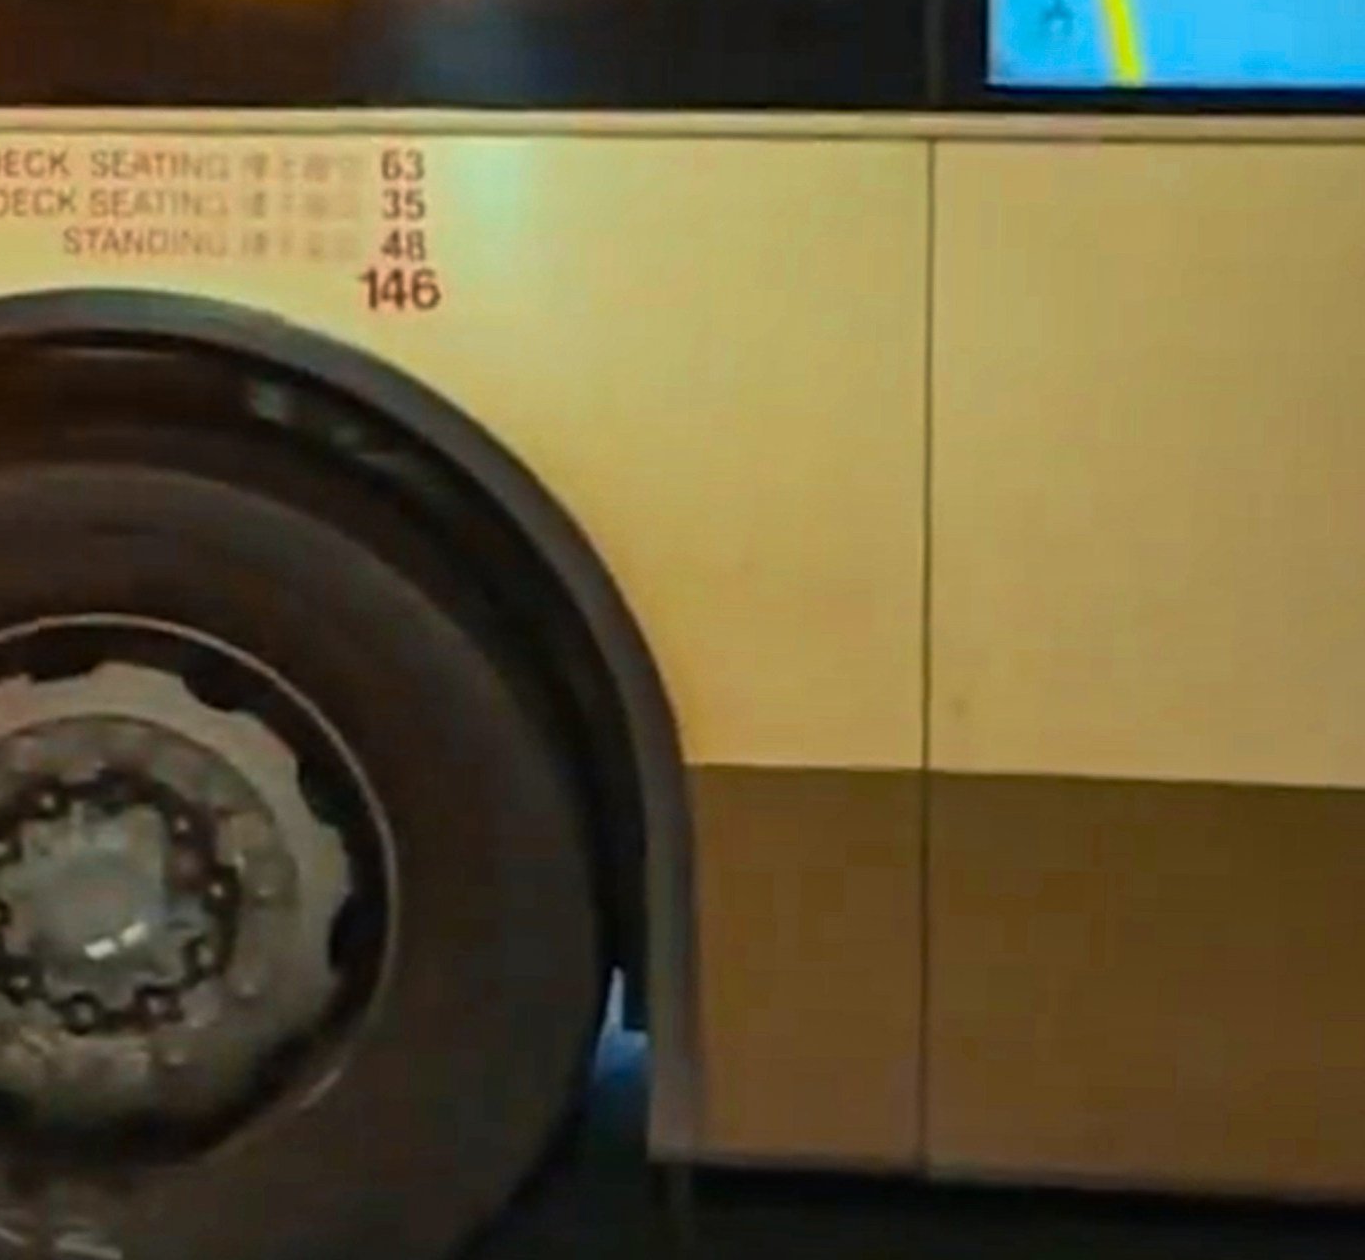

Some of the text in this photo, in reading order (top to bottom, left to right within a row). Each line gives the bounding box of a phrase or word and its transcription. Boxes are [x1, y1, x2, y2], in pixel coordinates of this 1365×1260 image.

[380, 148, 426, 181] 63
[381, 188, 427, 220] 35
[380, 228, 427, 262] 48
[359, 267, 442, 311] 146
